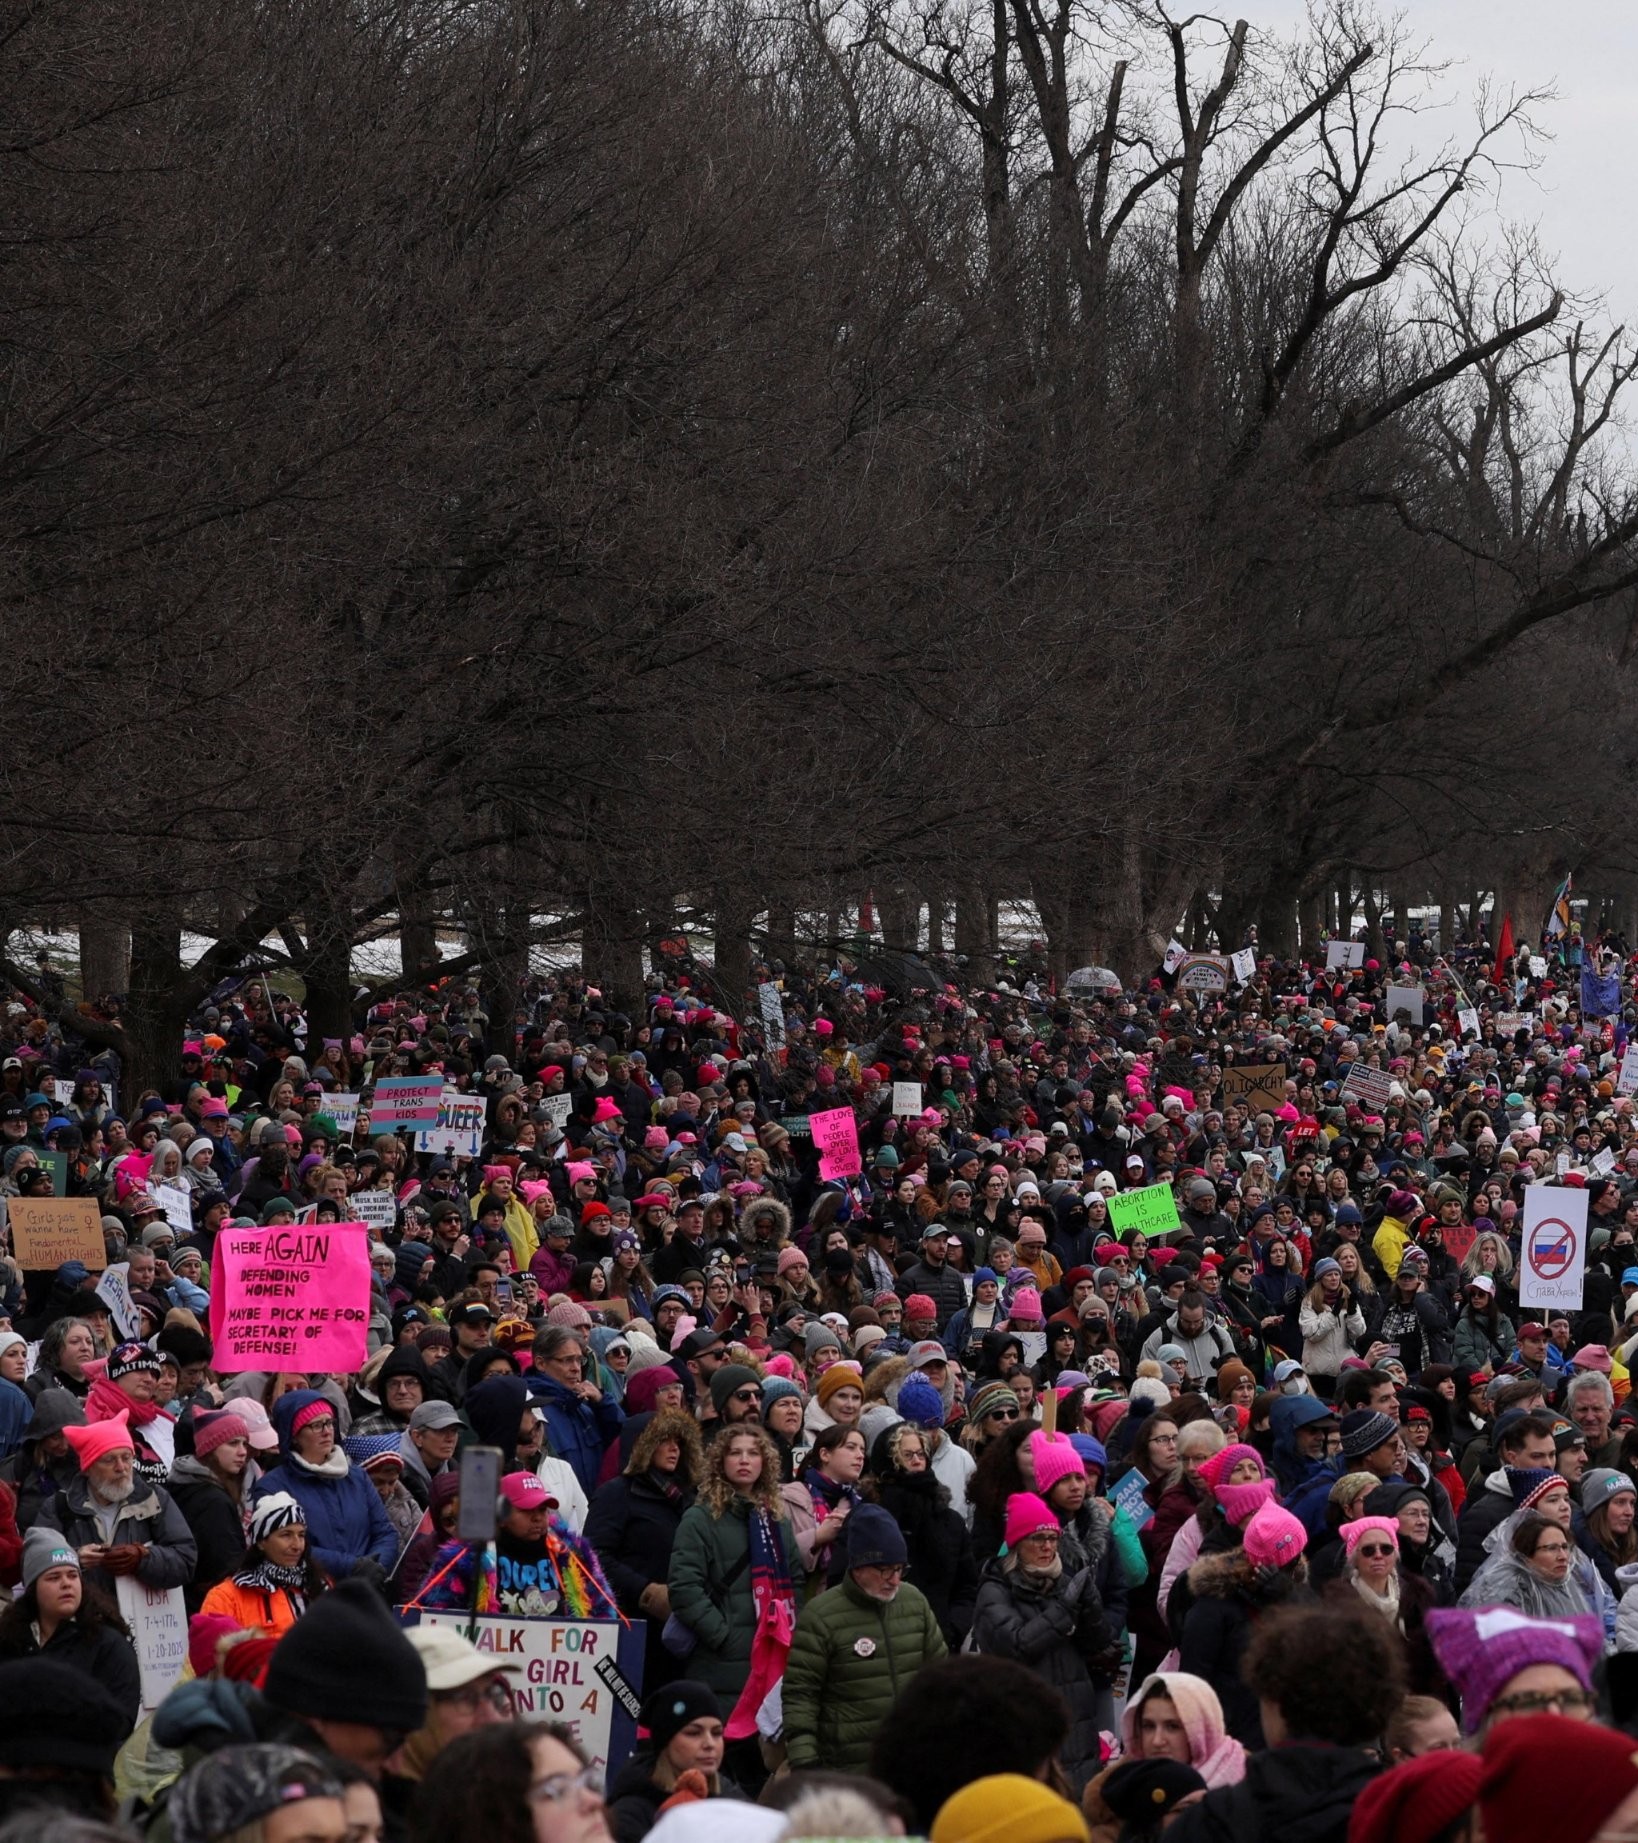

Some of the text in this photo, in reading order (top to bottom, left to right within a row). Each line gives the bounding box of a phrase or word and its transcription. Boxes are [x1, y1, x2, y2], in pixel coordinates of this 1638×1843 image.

[387, 1087, 430, 1097] PROTECT
[1224, 1077, 1283, 1094] OLIGARCHY
[394, 1098, 424, 1108] TRANS
[396, 1110, 417, 1120] KIDS
[812, 1110, 854, 1124] THE LOVE
[830, 1122, 840, 1132] OF
[1298, 1127, 1316, 1136] LET
[823, 1130, 852, 1142] PEOPLE
[830, 1139, 850, 1148] OVER
[822, 1146, 858, 1159] THE LOVE
[834, 1156, 846, 1164] OF
[830, 1162, 858, 1174] POWER
[1114, 1186, 1164, 1210] ABORTION
[27, 1210, 76, 1224] Girls just
[1136, 1204, 1148, 1216] IS
[25, 1224, 79, 1234] wanna have
[1116, 1212, 1174, 1234] HEALTHCARE
[230, 1232, 330, 1263] HERE AGAIN
[30, 1248, 104, 1262] HUMAN RIGHTS
[240, 1269, 310, 1284] DEFENDING
[246, 1284, 296, 1297] WOMEN
[228, 1308, 366, 1322] MAYBE PICK ME FOR
[228, 1325, 322, 1340] SECRETARY OF
[234, 1341, 297, 1356] DEFENSE!
[146, 1588, 170, 1606] USA
[456, 1624, 599, 1656] WALK FOR
[527, 1658, 584, 1686] GIRL
[597, 1658, 610, 1672] WE
[603, 1666, 619, 1684] WILL
[610, 1676, 626, 1692] NOT
[618, 1686, 630, 1698] BE
[580, 1689, 598, 1714] A
